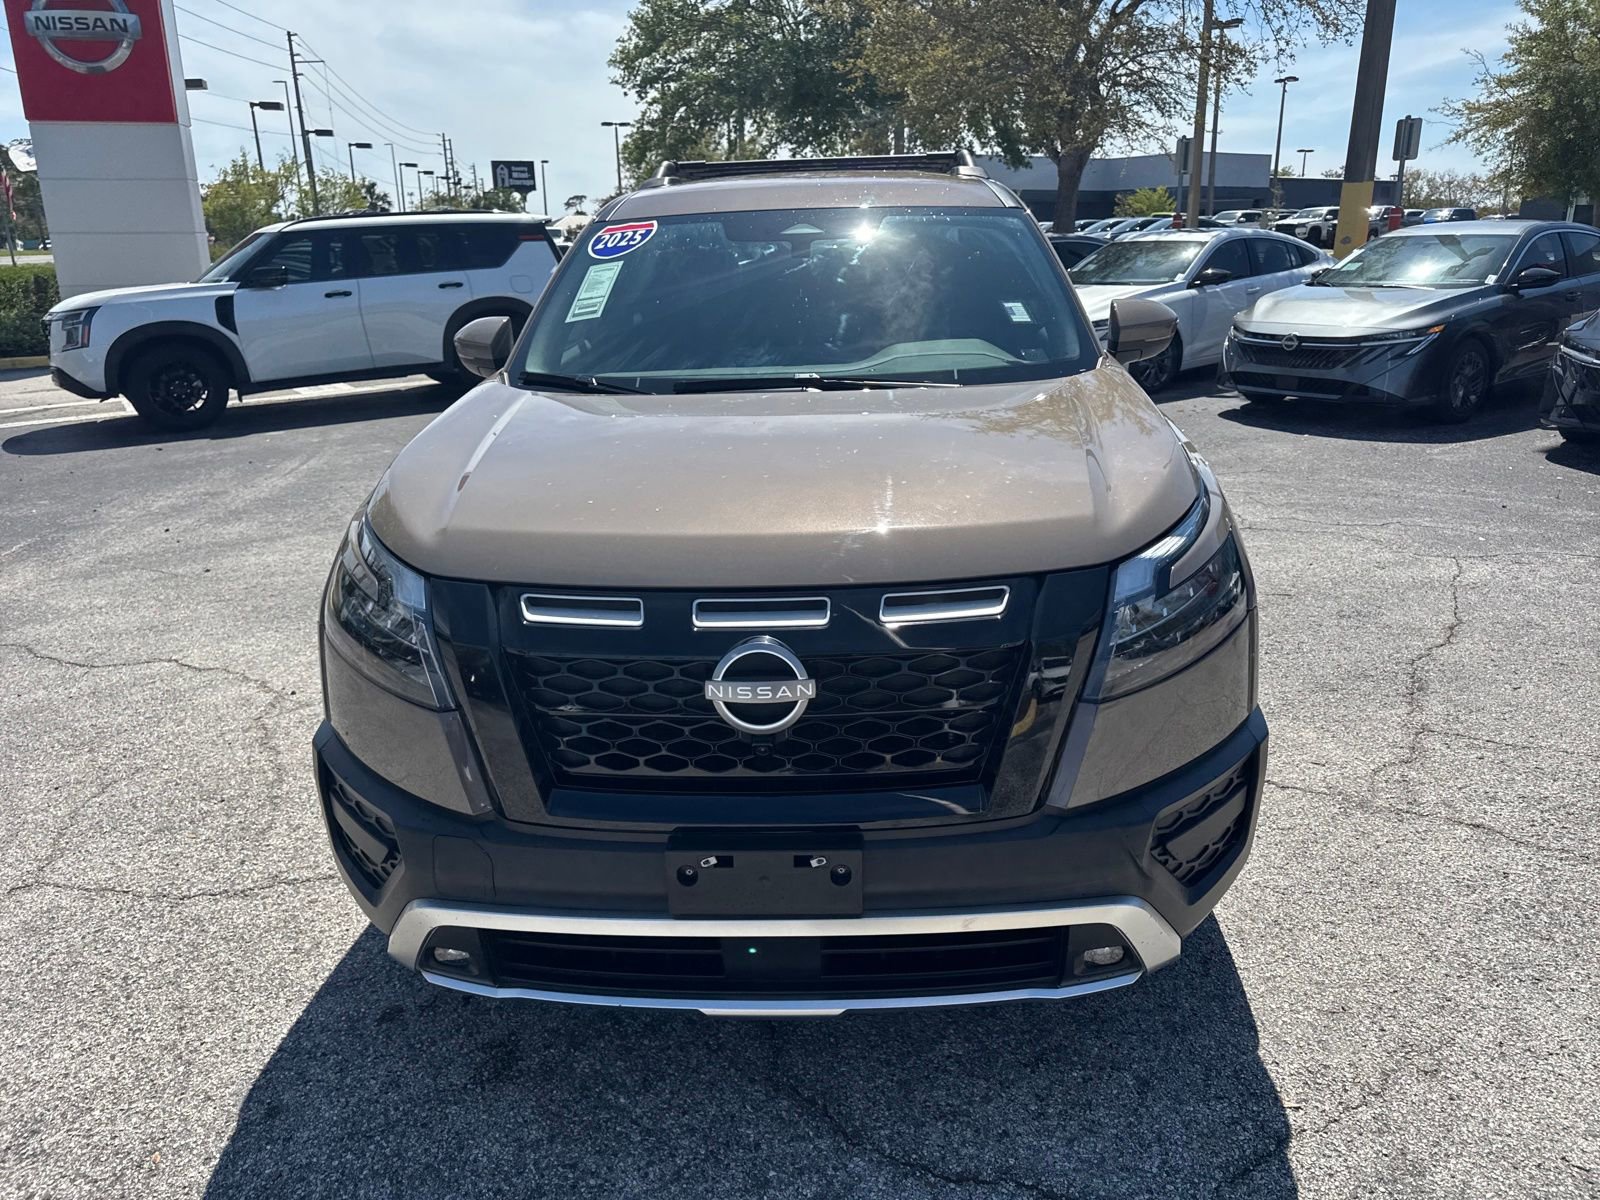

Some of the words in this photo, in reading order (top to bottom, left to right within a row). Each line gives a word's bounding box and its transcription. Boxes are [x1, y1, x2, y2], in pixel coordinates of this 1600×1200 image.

[33, 15, 129, 33] NISSAN
[593, 229, 646, 250] 2025
[708, 682, 813, 699] NISSAN
